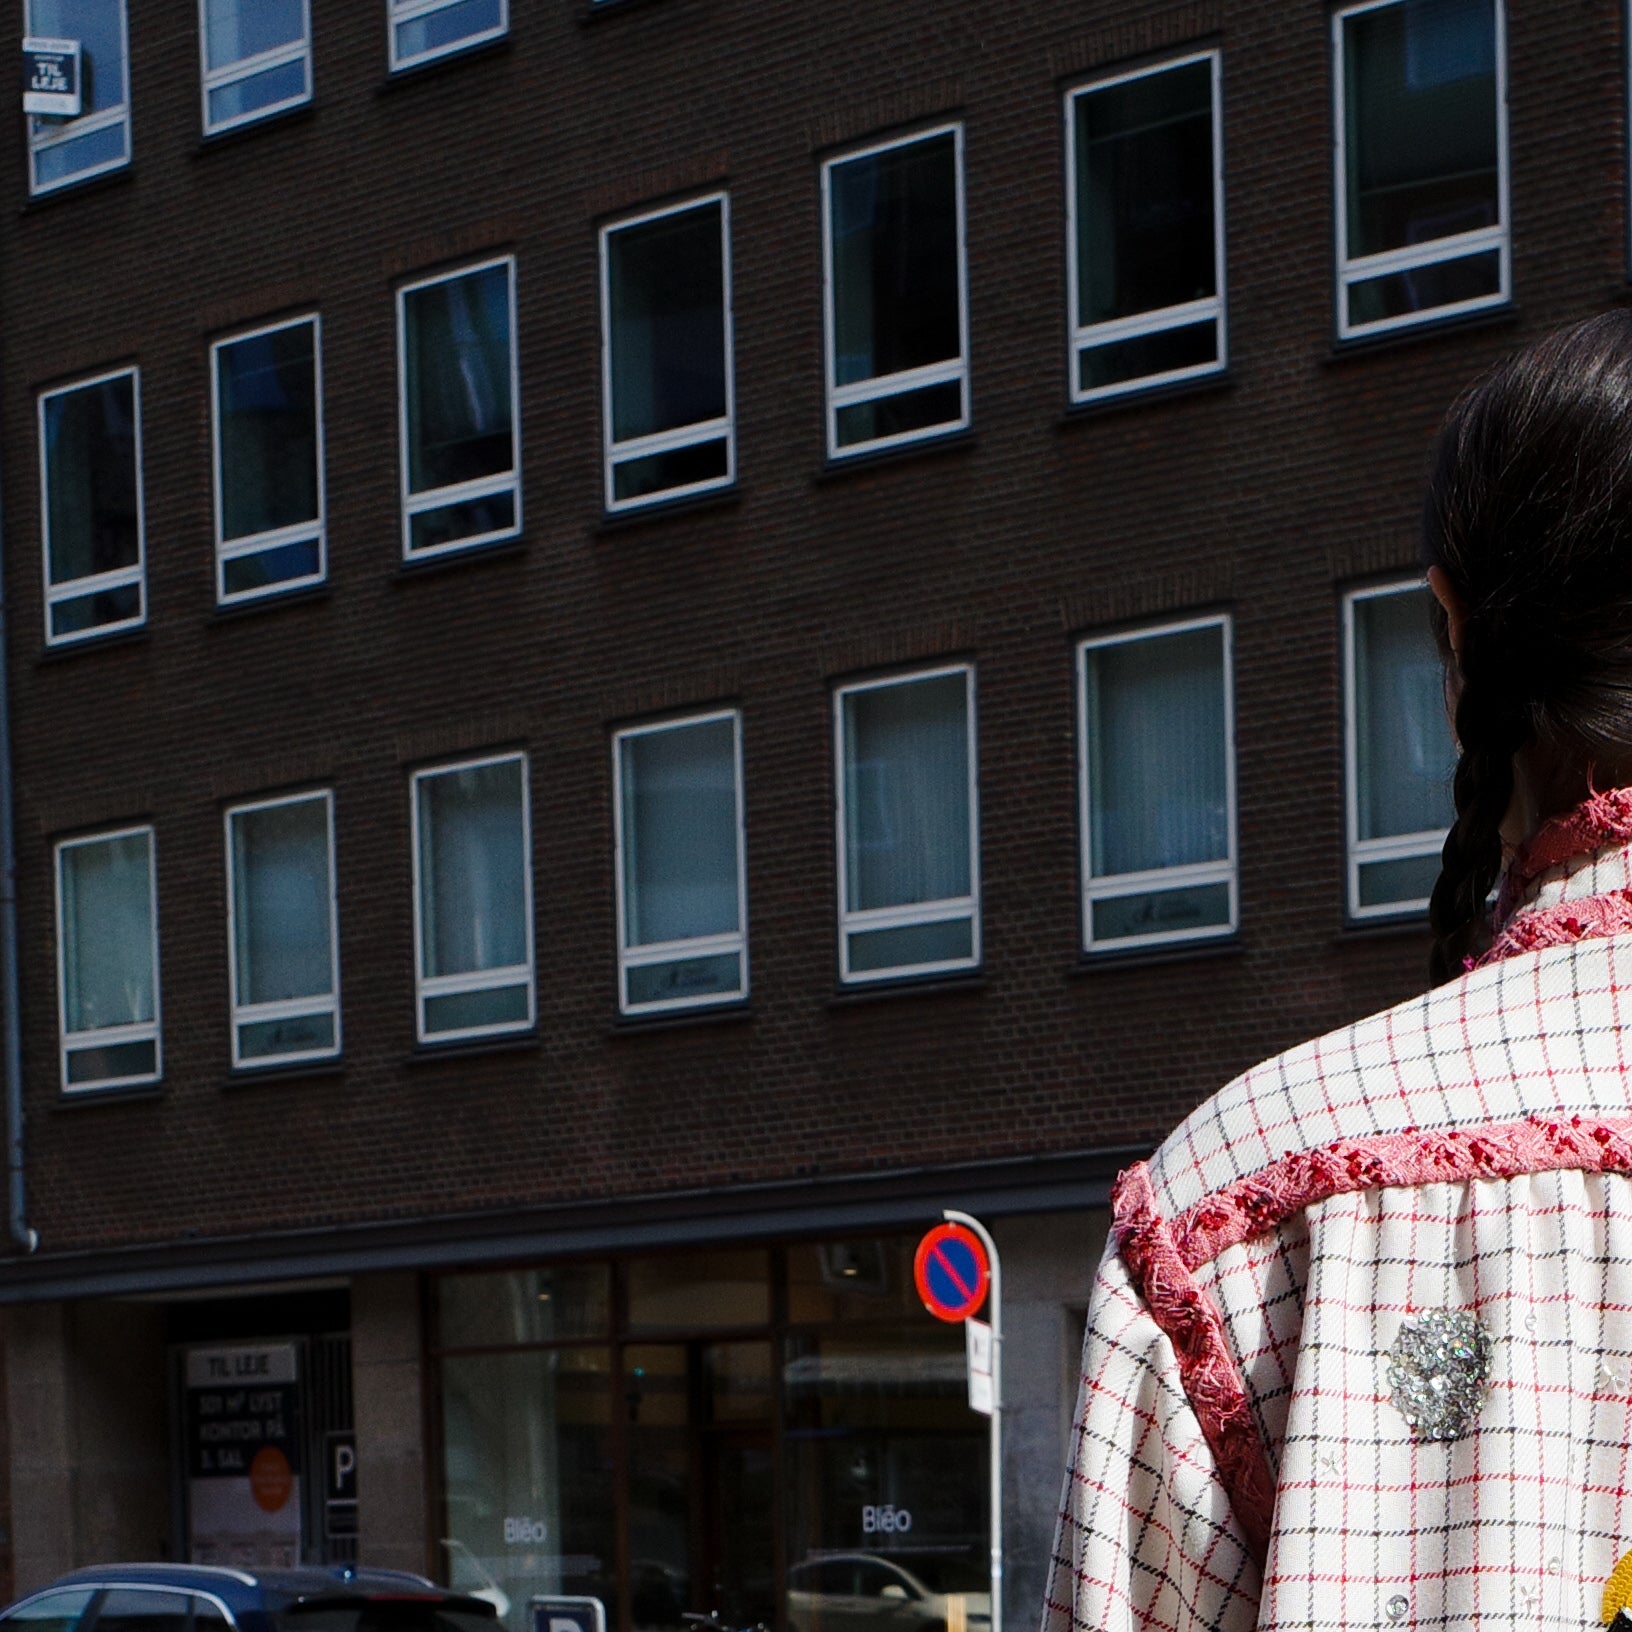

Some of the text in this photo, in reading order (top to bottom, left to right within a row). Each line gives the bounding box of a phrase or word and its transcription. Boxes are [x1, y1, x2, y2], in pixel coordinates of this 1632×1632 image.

[35, 62, 63, 77] TIL
[31, 75, 68, 91] LEJE
[208, 1354, 269, 1377] TIL LEJE
[199, 1413, 287, 1443] KONTOR PÅ
[336, 1444, 355, 1490] P
